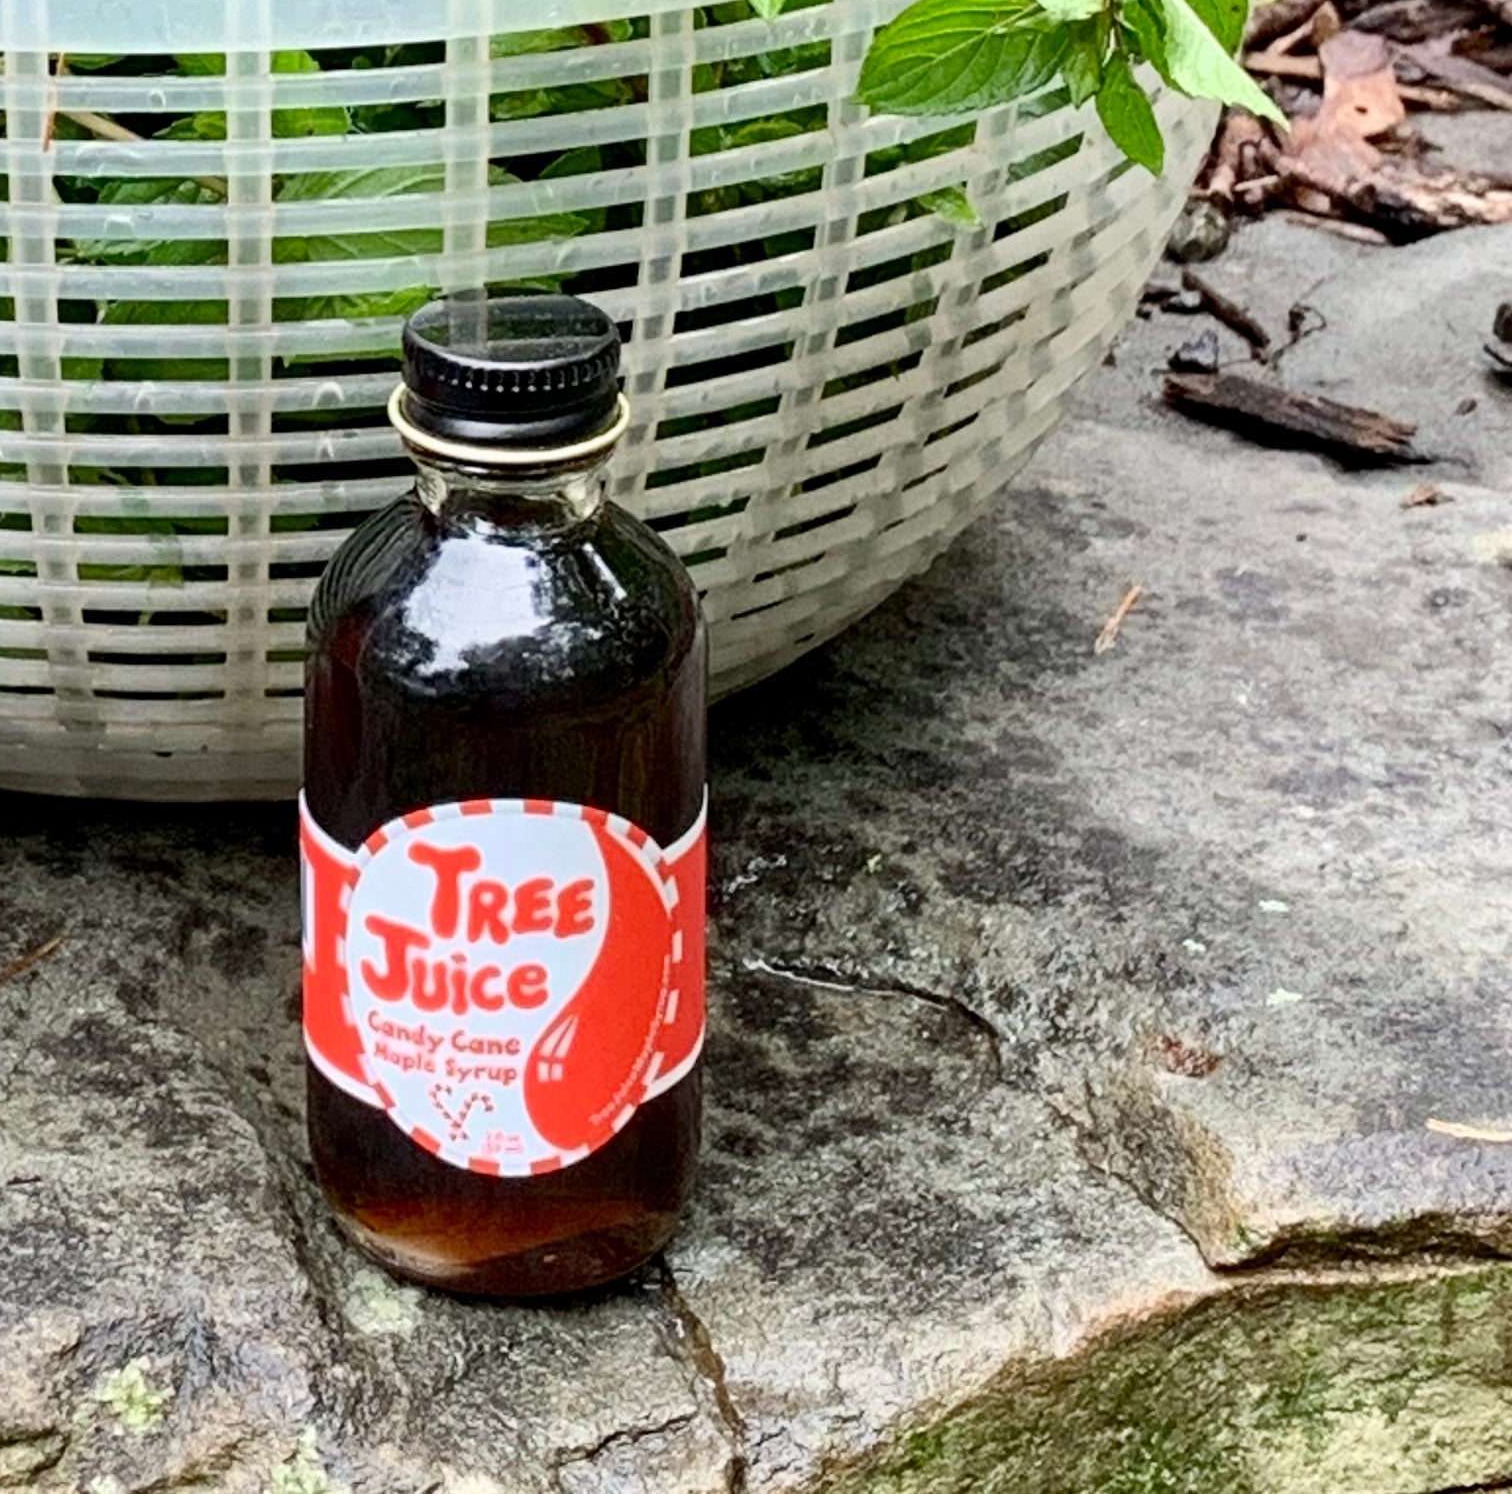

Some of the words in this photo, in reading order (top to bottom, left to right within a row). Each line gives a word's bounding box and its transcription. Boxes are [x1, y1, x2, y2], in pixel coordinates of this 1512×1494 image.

[408, 841, 594, 944] TREE
[361, 915, 548, 1015] Juice
[367, 1010, 445, 1054] Candy
[451, 1029, 520, 1055] Cane
[374, 1041, 436, 1073] Maple
[445, 1058, 518, 1086] Syrup
